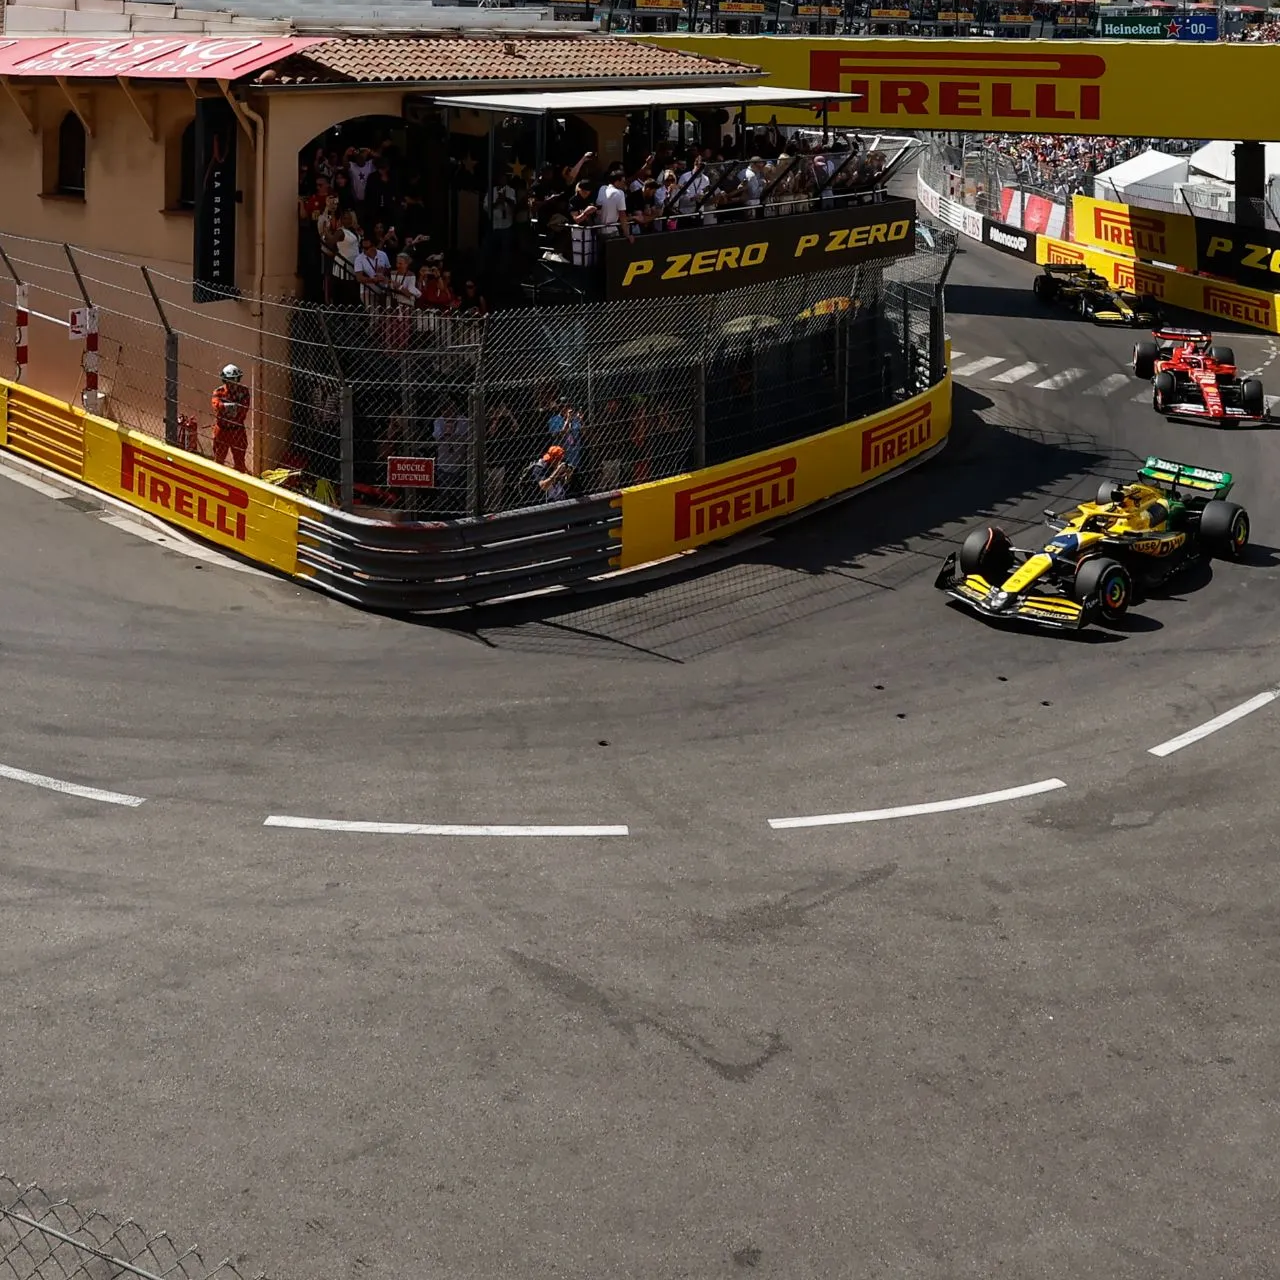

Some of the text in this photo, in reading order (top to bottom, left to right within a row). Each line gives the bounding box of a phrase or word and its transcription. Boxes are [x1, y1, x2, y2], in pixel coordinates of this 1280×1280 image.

[51, 40, 263, 60] CASINO
[1105, 23, 1162, 35] Heineken
[807, 51, 1106, 120] PIRELLI
[212, 171, 222, 277] LA RASCASSE
[794, 219, 911, 258] P ZERO
[1094, 207, 1166, 255] PIRELLI
[1206, 236, 1234, 258] P
[622, 241, 769, 287] P ZERO
[1113, 262, 1166, 298] PIRELLI
[1202, 286, 1271, 326] PIRELLI
[861, 401, 933, 474] PIRELLI
[120, 442, 249, 542] PIRELLI
[674, 456, 797, 542] PIRELLI
